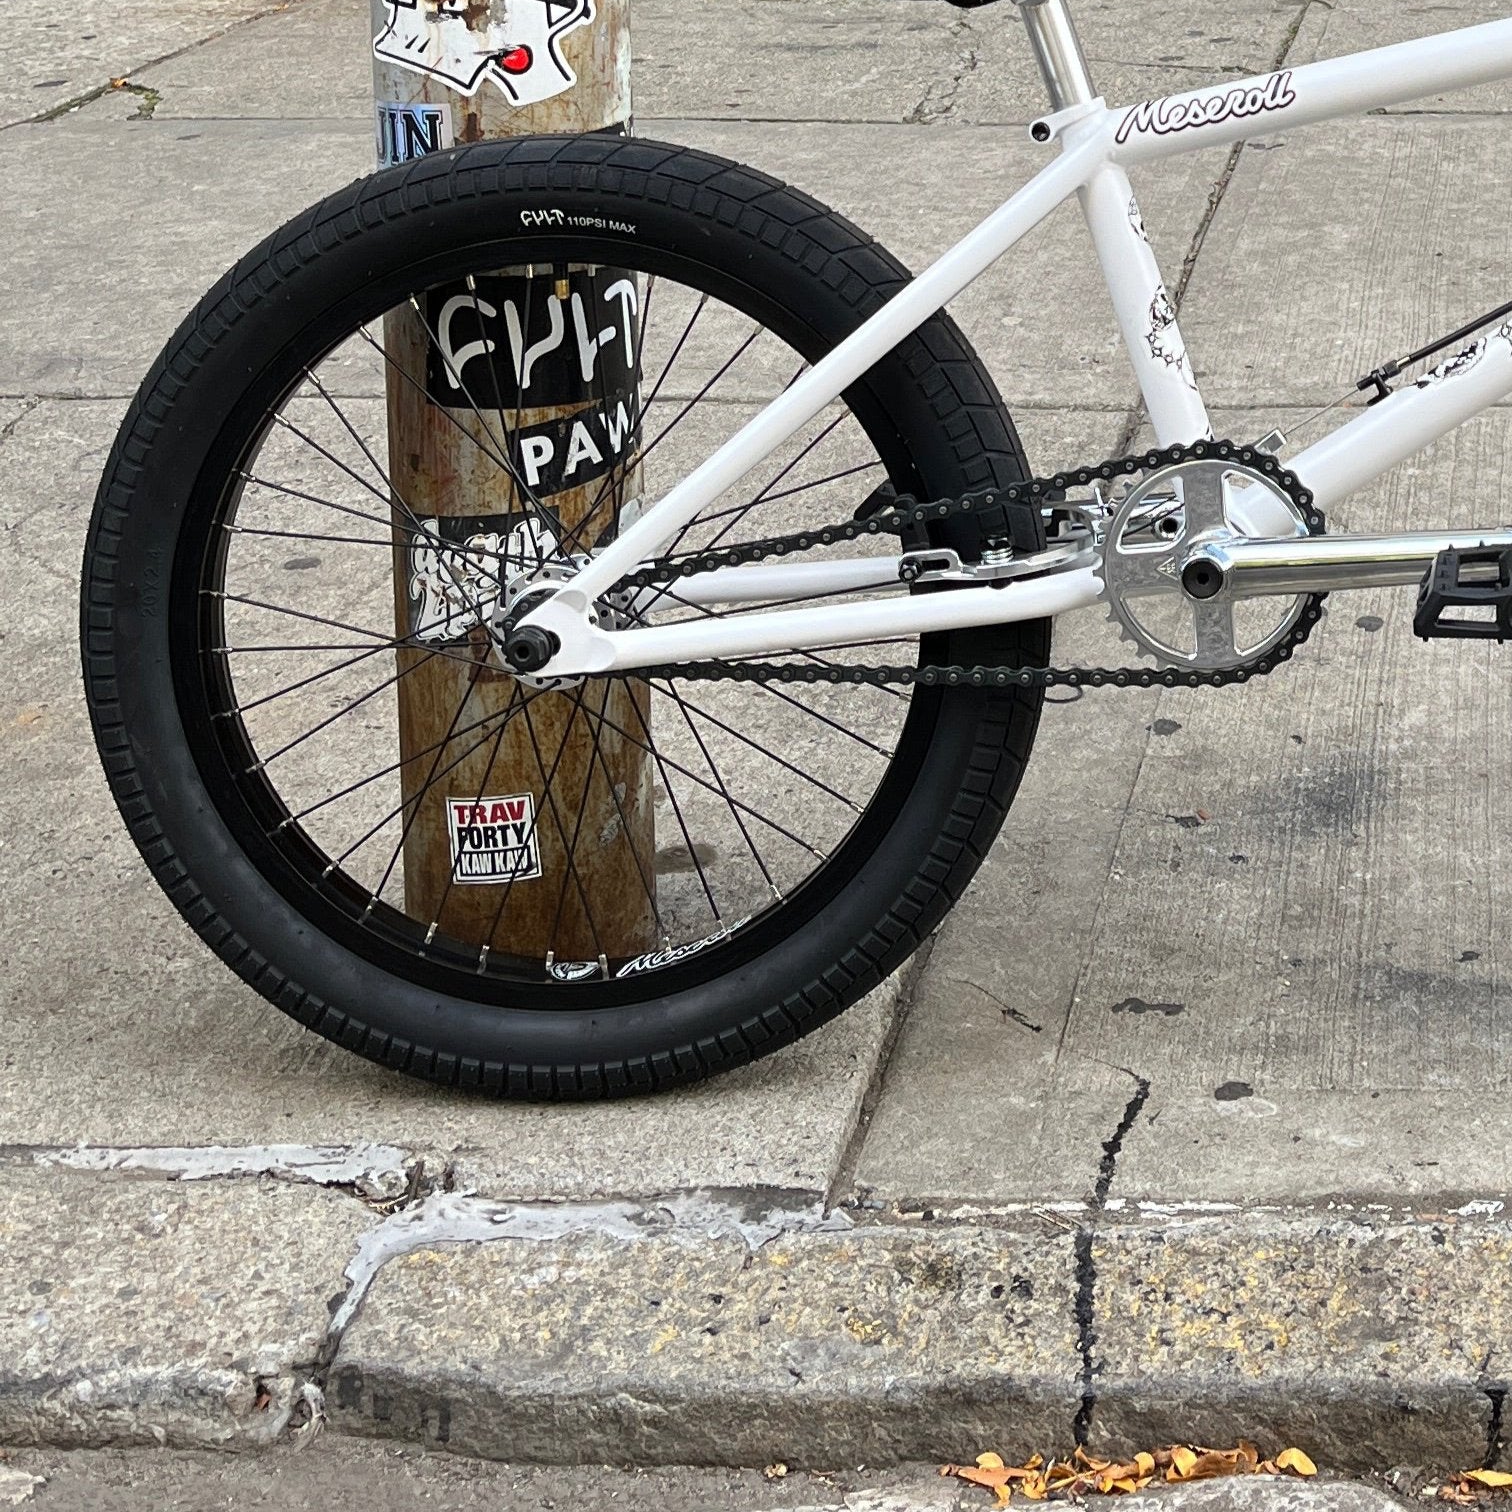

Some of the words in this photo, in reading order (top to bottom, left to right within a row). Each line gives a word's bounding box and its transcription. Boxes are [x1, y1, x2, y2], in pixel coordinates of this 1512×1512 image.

[1114, 70, 1297, 144] Meseroll
[519, 208, 565, 227] CULT
[567, 216, 607, 229] 110PSI
[609, 220, 637, 235] MAX
[437, 279, 638, 390] CULT
[453, 799, 526, 825] TRAV
[461, 852, 493, 875] KAW
